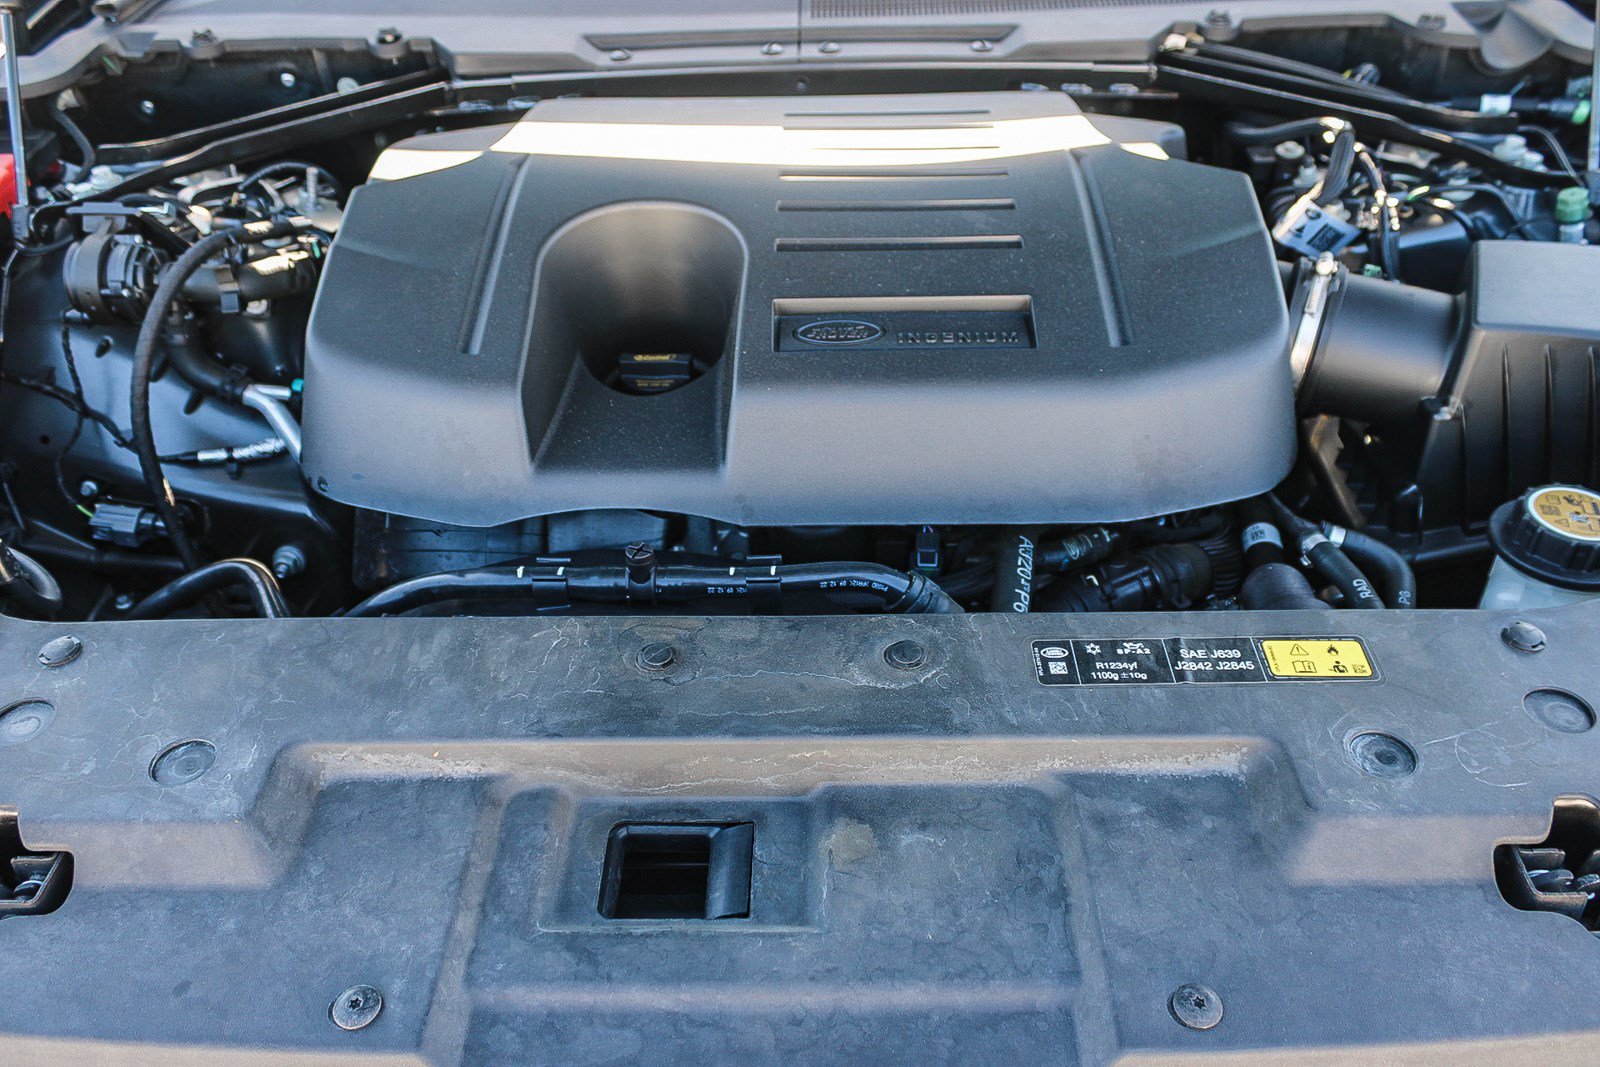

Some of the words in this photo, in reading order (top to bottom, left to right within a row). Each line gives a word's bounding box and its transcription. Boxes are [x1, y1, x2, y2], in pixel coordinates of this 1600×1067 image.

[897, 331, 1018, 343] INGENIUM
[1352, 579, 1374, 599] RAD
[1398, 590, 1411, 605] P8
[1180, 649, 1207, 659] SAE
[1210, 649, 1242, 659] J639
[1095, 661, 1138, 670] R1234yf
[1175, 661, 1213, 671] J2842
[1216, 661, 1255, 670] J2845
[1091, 672, 1119, 680] 1100g
